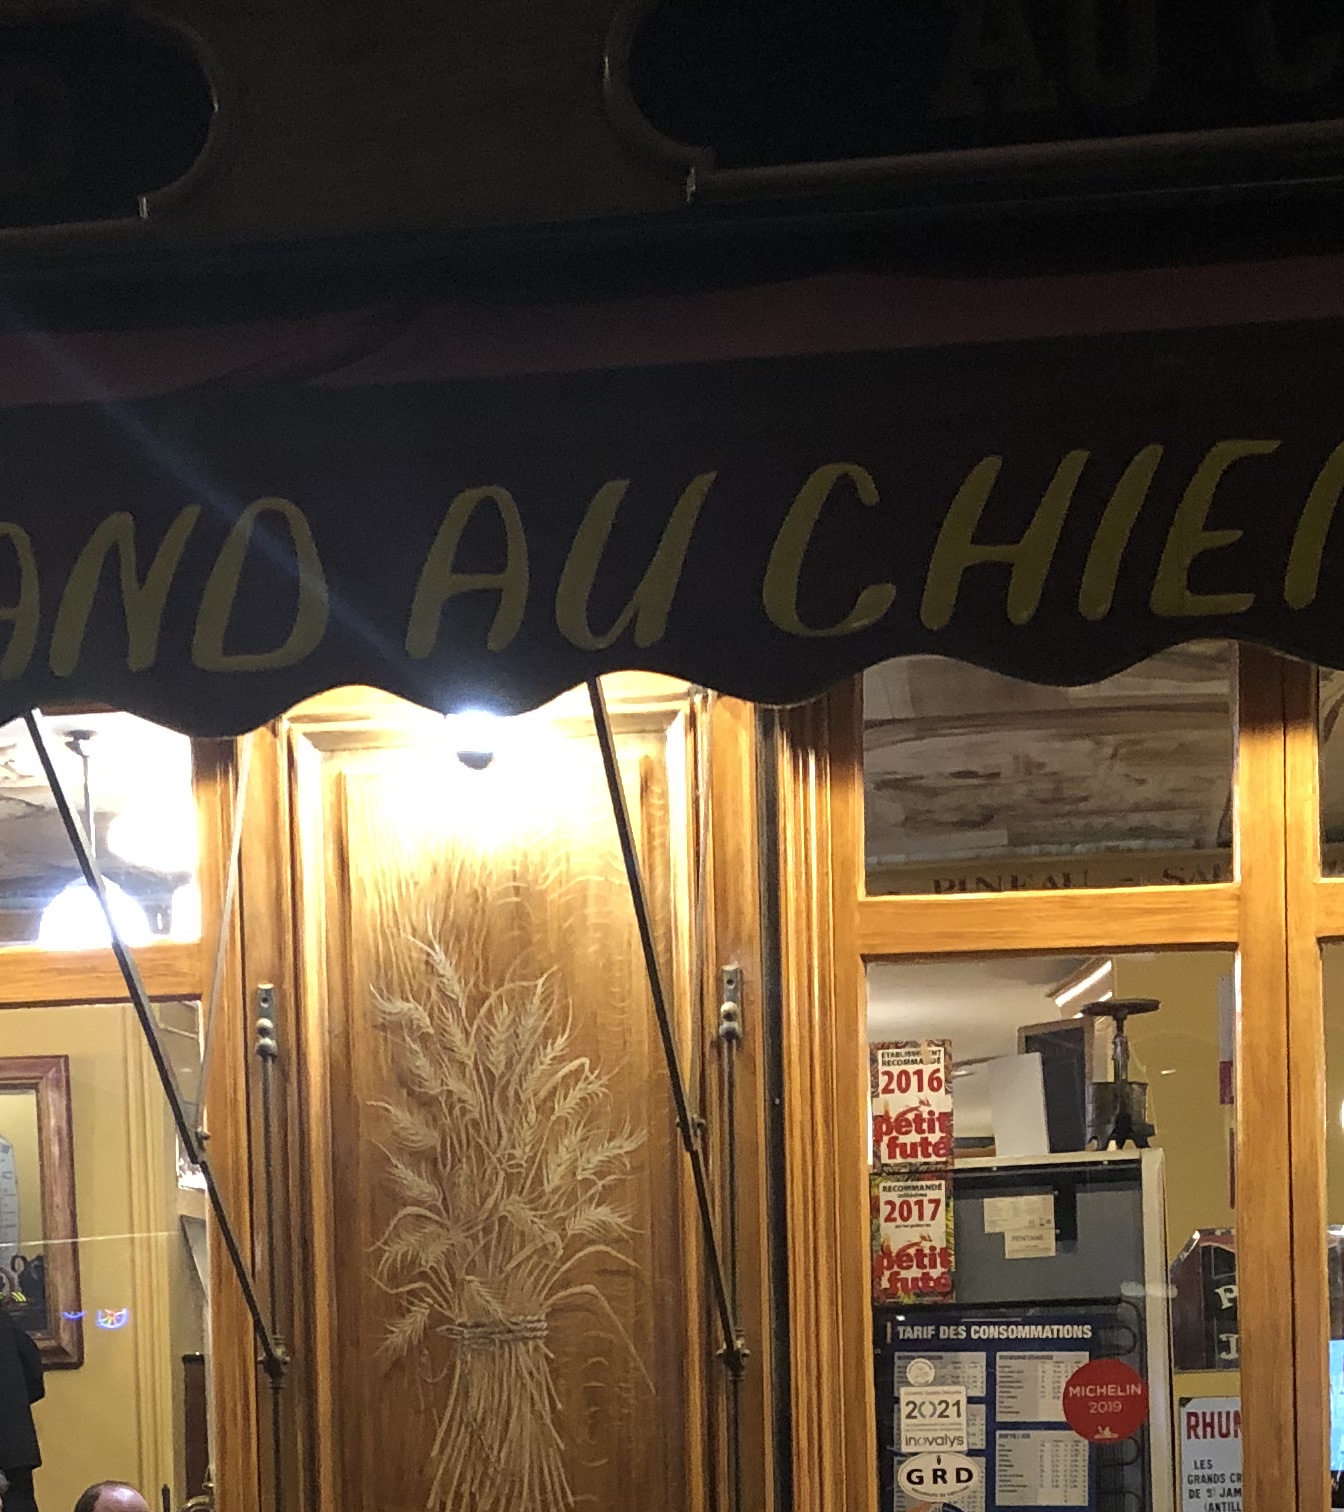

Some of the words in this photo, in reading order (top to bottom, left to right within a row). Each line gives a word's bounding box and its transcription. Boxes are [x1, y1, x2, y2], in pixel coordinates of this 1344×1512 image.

[405, 471, 717, 661] AU
[881, 1068, 943, 1095] 2016
[873, 1109, 953, 1144] petit
[887, 1135, 952, 1160] futé
[882, 1183, 943, 1193] RECOMMANDÉ
[883, 1198, 942, 1223] 2017
[875, 1245, 953, 1277] petit
[888, 1271, 952, 1295] futé
[898, 1325, 935, 1340] TARIF
[940, 1325, 967, 1339] DES
[971, 1324, 1093, 1340] CONSOMMATIONS
[1068, 1382, 1143, 1399] MICHELIN
[905, 1400, 962, 1420] 2021
[1088, 1400, 1123, 1414] 2019
[905, 1433, 965, 1448] inovalys
[1193, 1459, 1213, 1470] LES
[1187, 1473, 1226, 1485] GRANDS
[1188, 1488, 1201, 1500] DE
